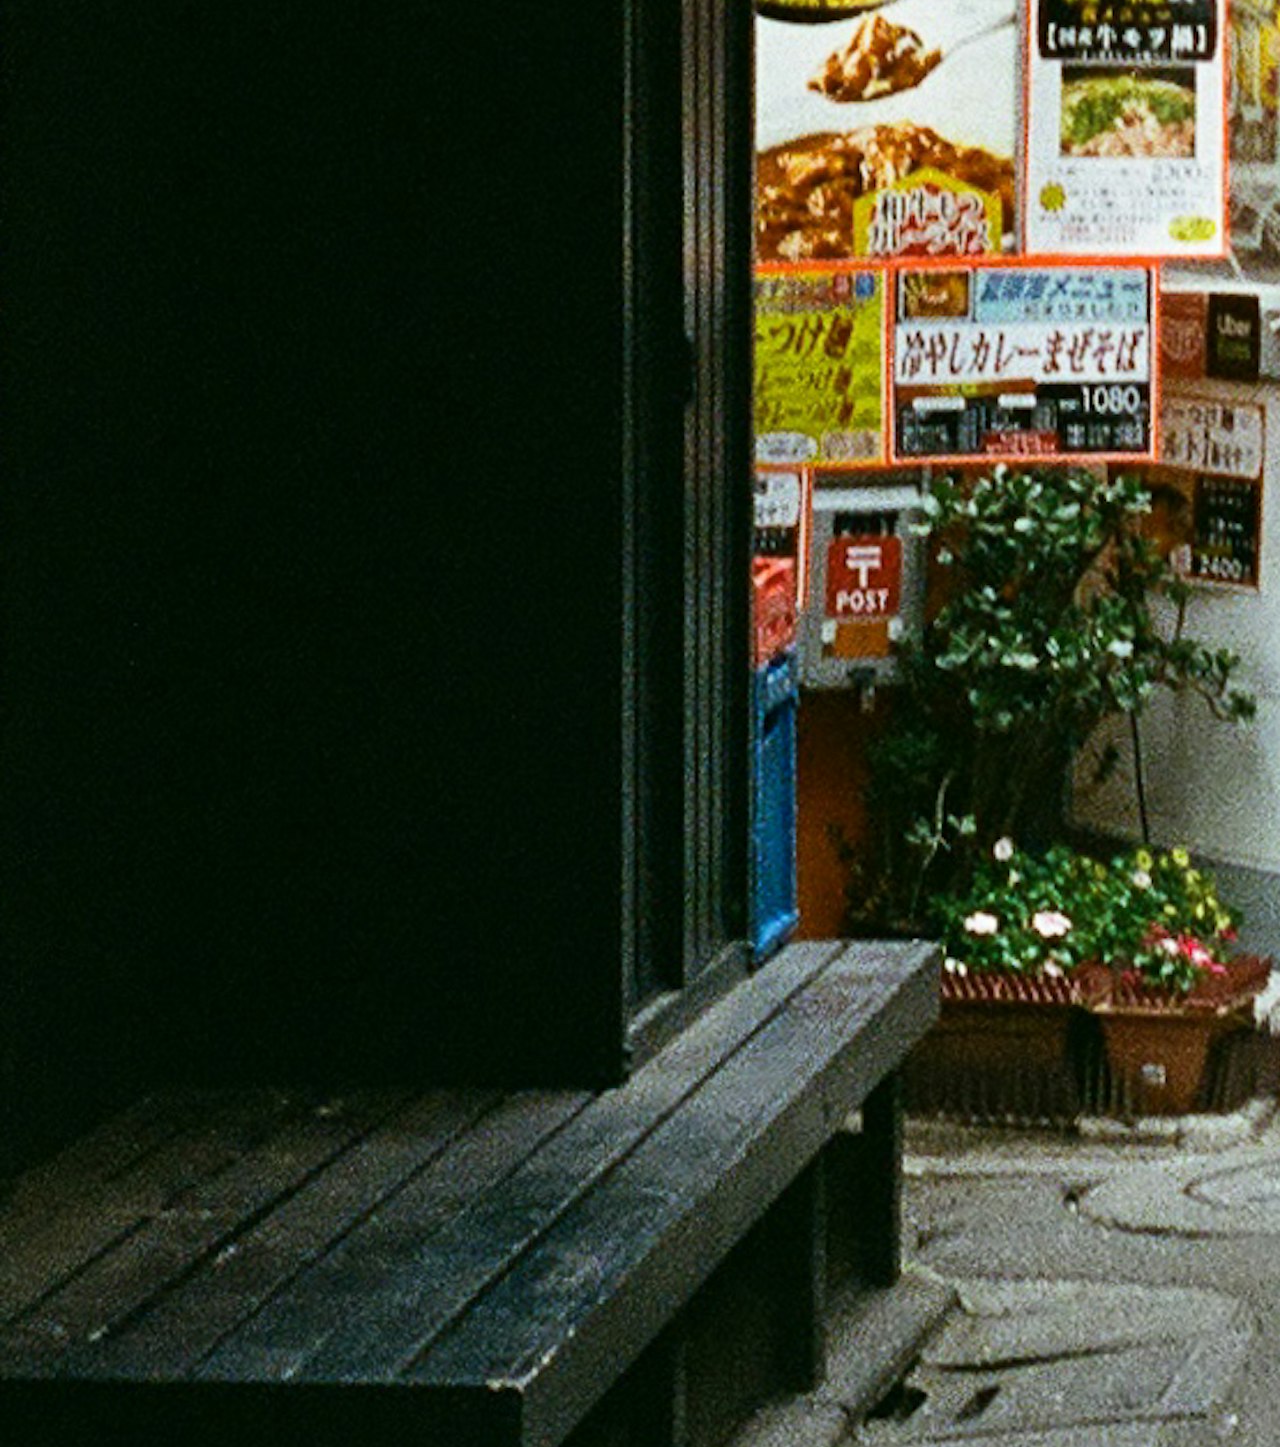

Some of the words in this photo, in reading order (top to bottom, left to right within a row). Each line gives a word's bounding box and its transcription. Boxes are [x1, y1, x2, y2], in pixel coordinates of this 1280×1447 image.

[900, 330, 1144, 376] 冷やしカレーまぜそば
[1082, 385, 1140, 413] 1080
[836, 588, 889, 611] POST
